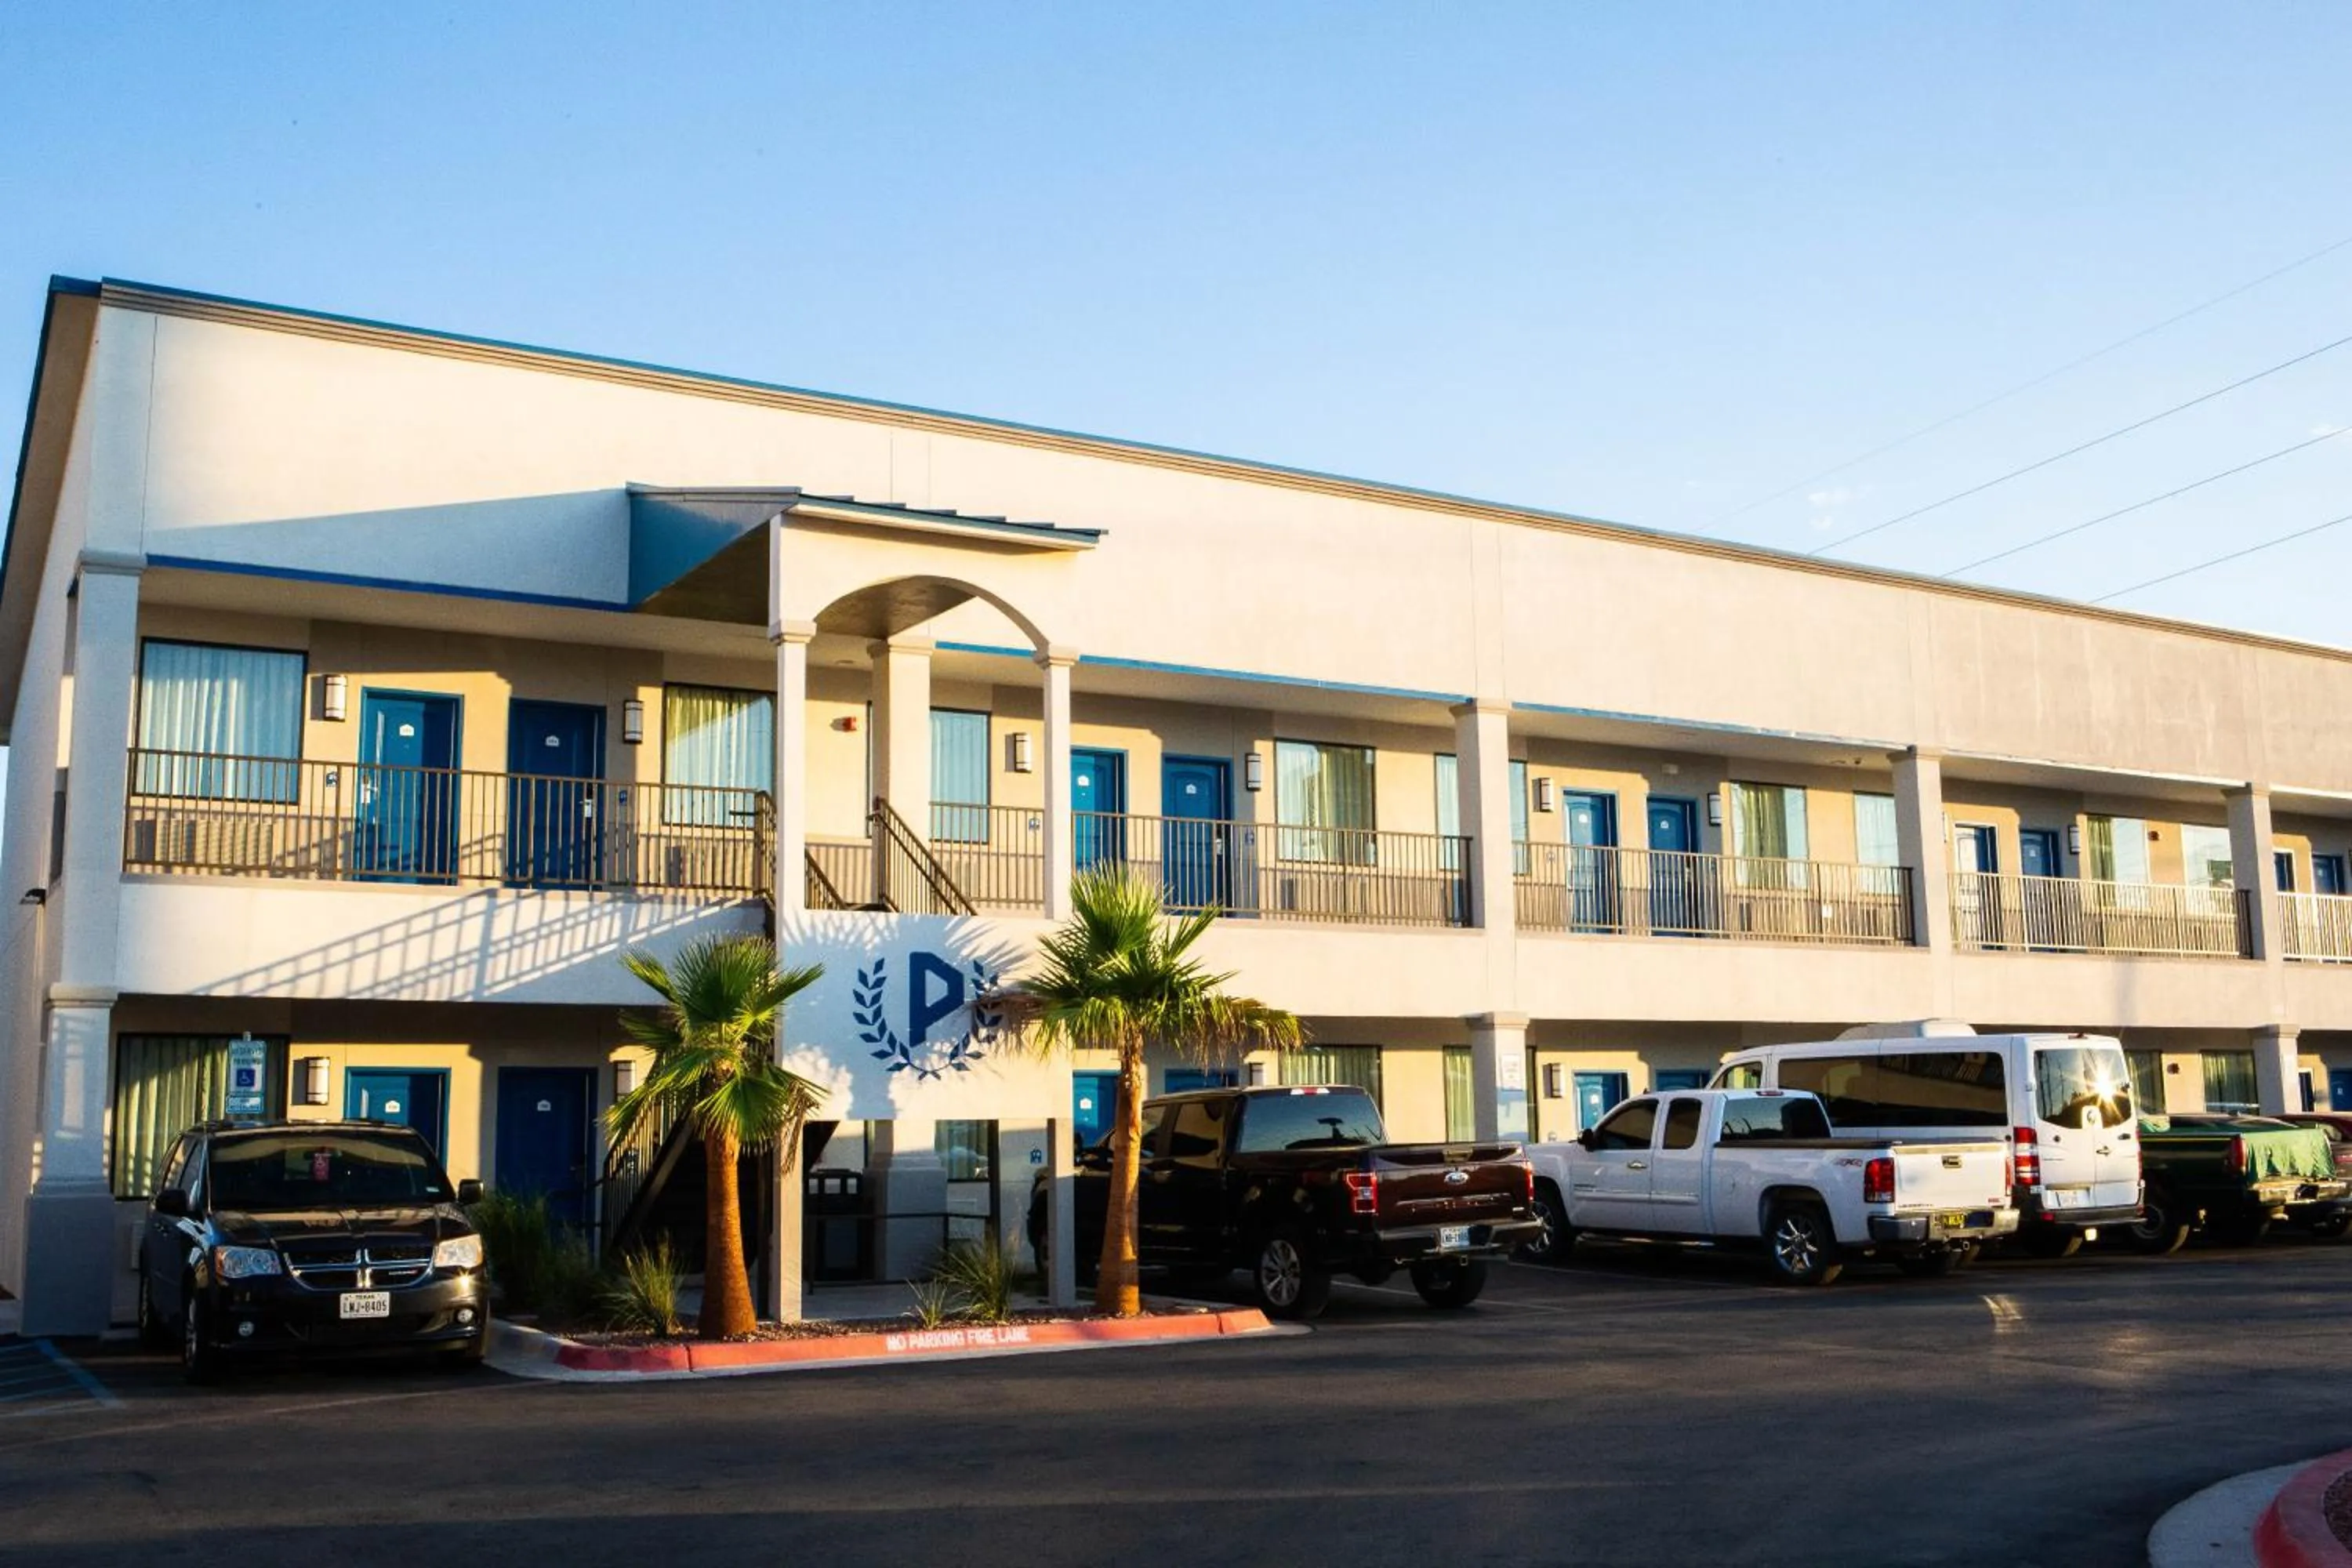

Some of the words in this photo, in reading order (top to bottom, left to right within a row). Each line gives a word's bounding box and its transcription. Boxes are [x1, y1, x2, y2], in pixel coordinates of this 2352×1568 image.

[909, 951, 964, 1048] P
[887, 1335, 906, 1351] NO
[909, 1330, 965, 1348] PARKING
[967, 1328, 996, 1345] FIRE
[998, 1327, 1030, 1342] LANE
